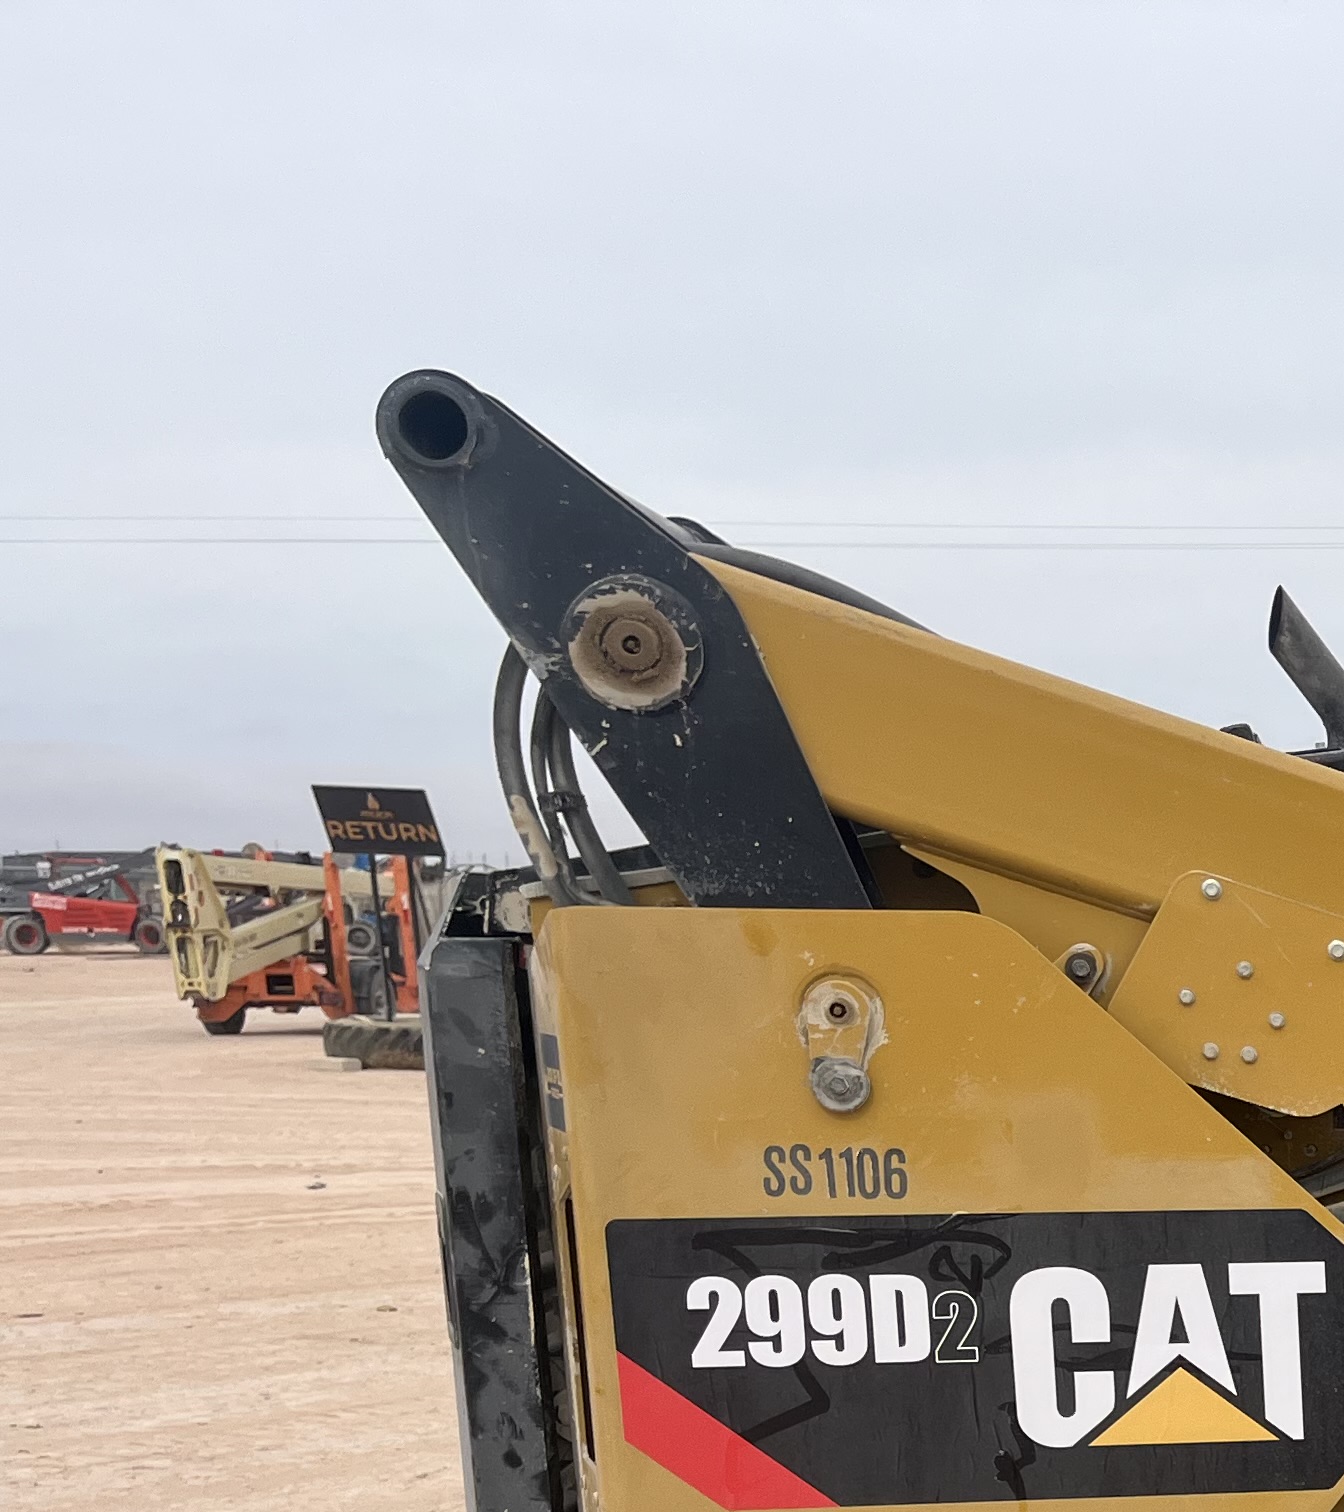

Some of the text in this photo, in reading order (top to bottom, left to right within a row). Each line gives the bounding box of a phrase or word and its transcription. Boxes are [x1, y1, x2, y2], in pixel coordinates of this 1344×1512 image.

[326, 820, 439, 842] RETURN
[763, 1143, 908, 1200] SS1106
[686, 1273, 980, 1368] 299D2
[1009, 1260, 1327, 1448] CAT
